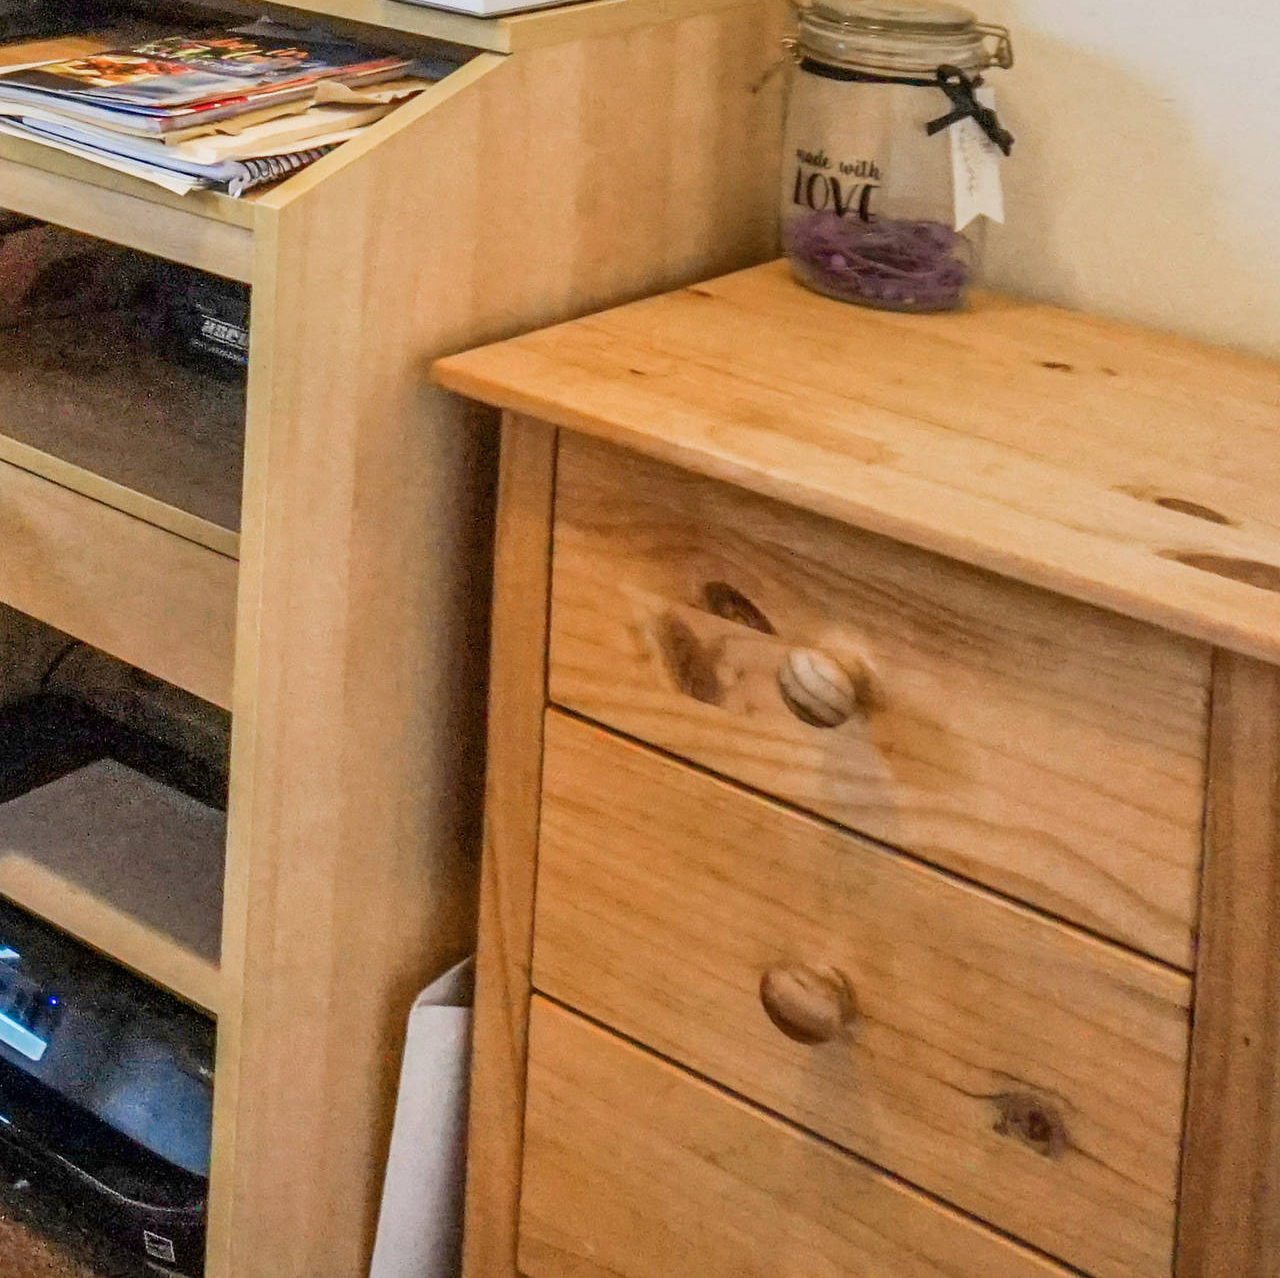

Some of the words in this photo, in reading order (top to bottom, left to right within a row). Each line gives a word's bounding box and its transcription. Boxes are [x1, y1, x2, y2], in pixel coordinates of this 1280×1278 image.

[796, 148, 832, 170] made
[839, 160, 883, 181] with
[793, 165, 881, 224] LOVE
